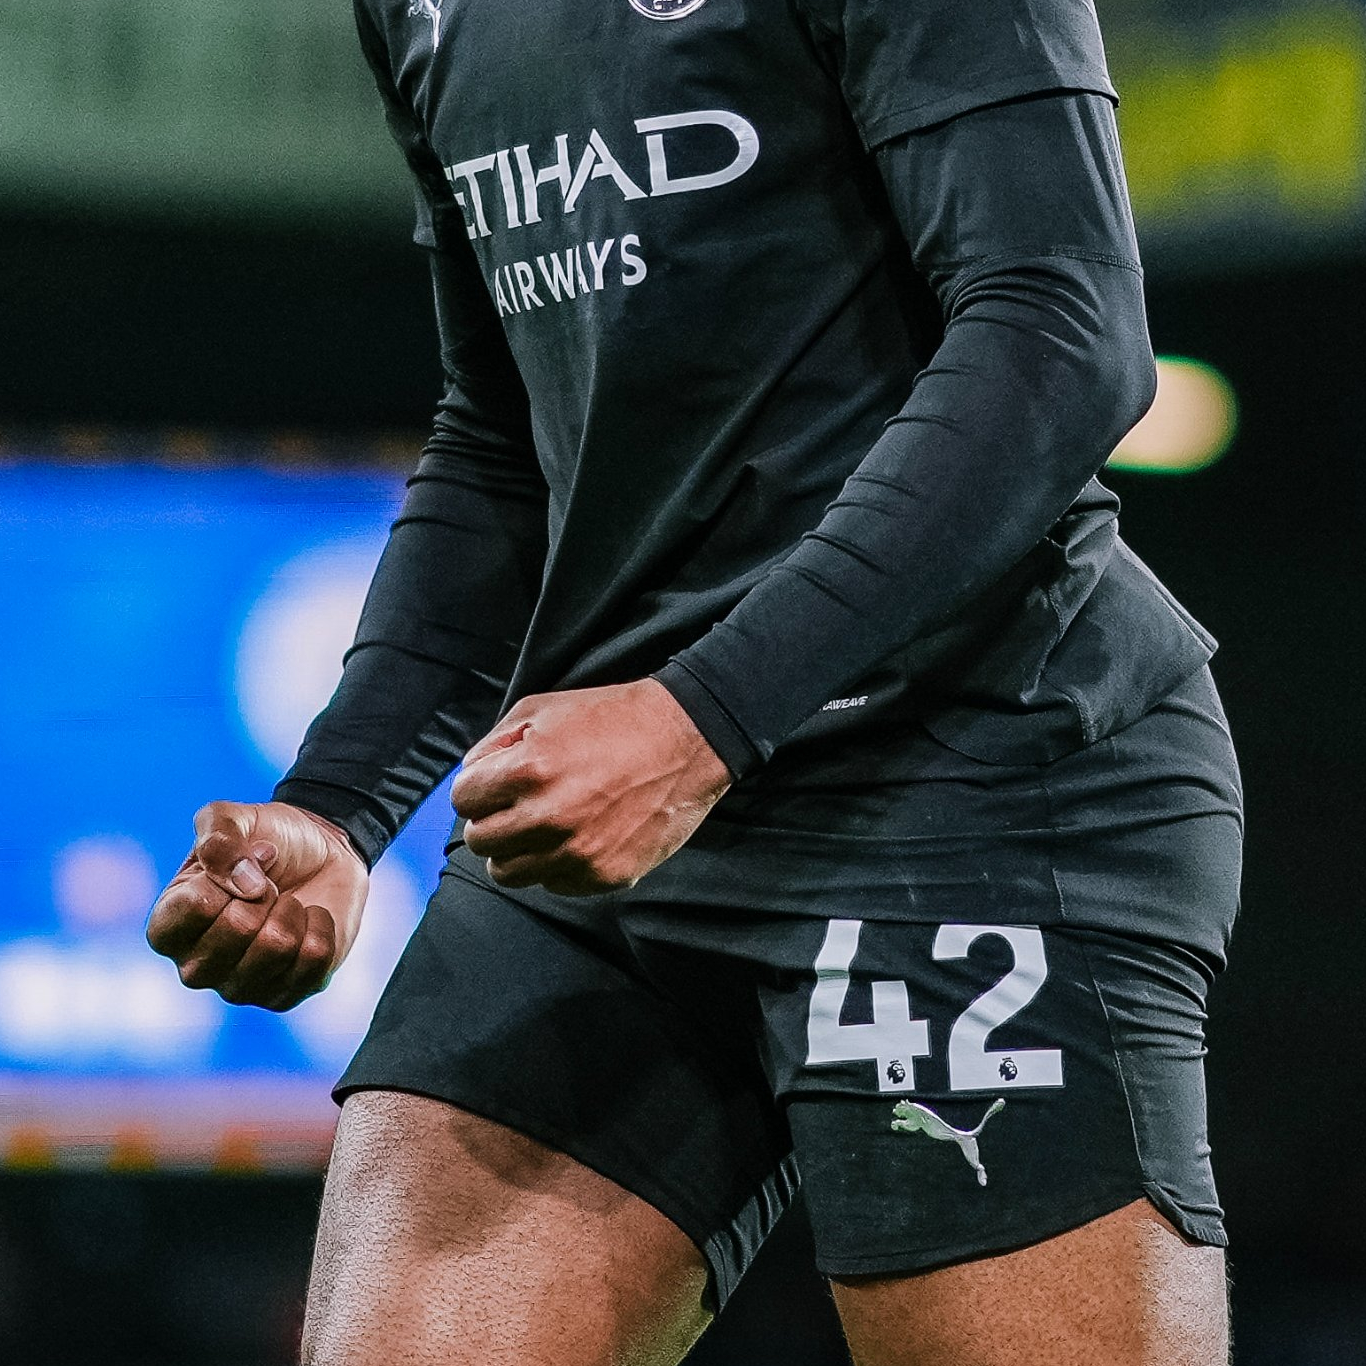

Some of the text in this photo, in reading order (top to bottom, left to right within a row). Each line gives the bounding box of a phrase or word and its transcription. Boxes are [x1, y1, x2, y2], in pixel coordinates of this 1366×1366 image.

[494, 233, 648, 318] AIRWAYS
[822, 695, 869, 711] AWEAVE
[805, 918, 1064, 1092] 42
